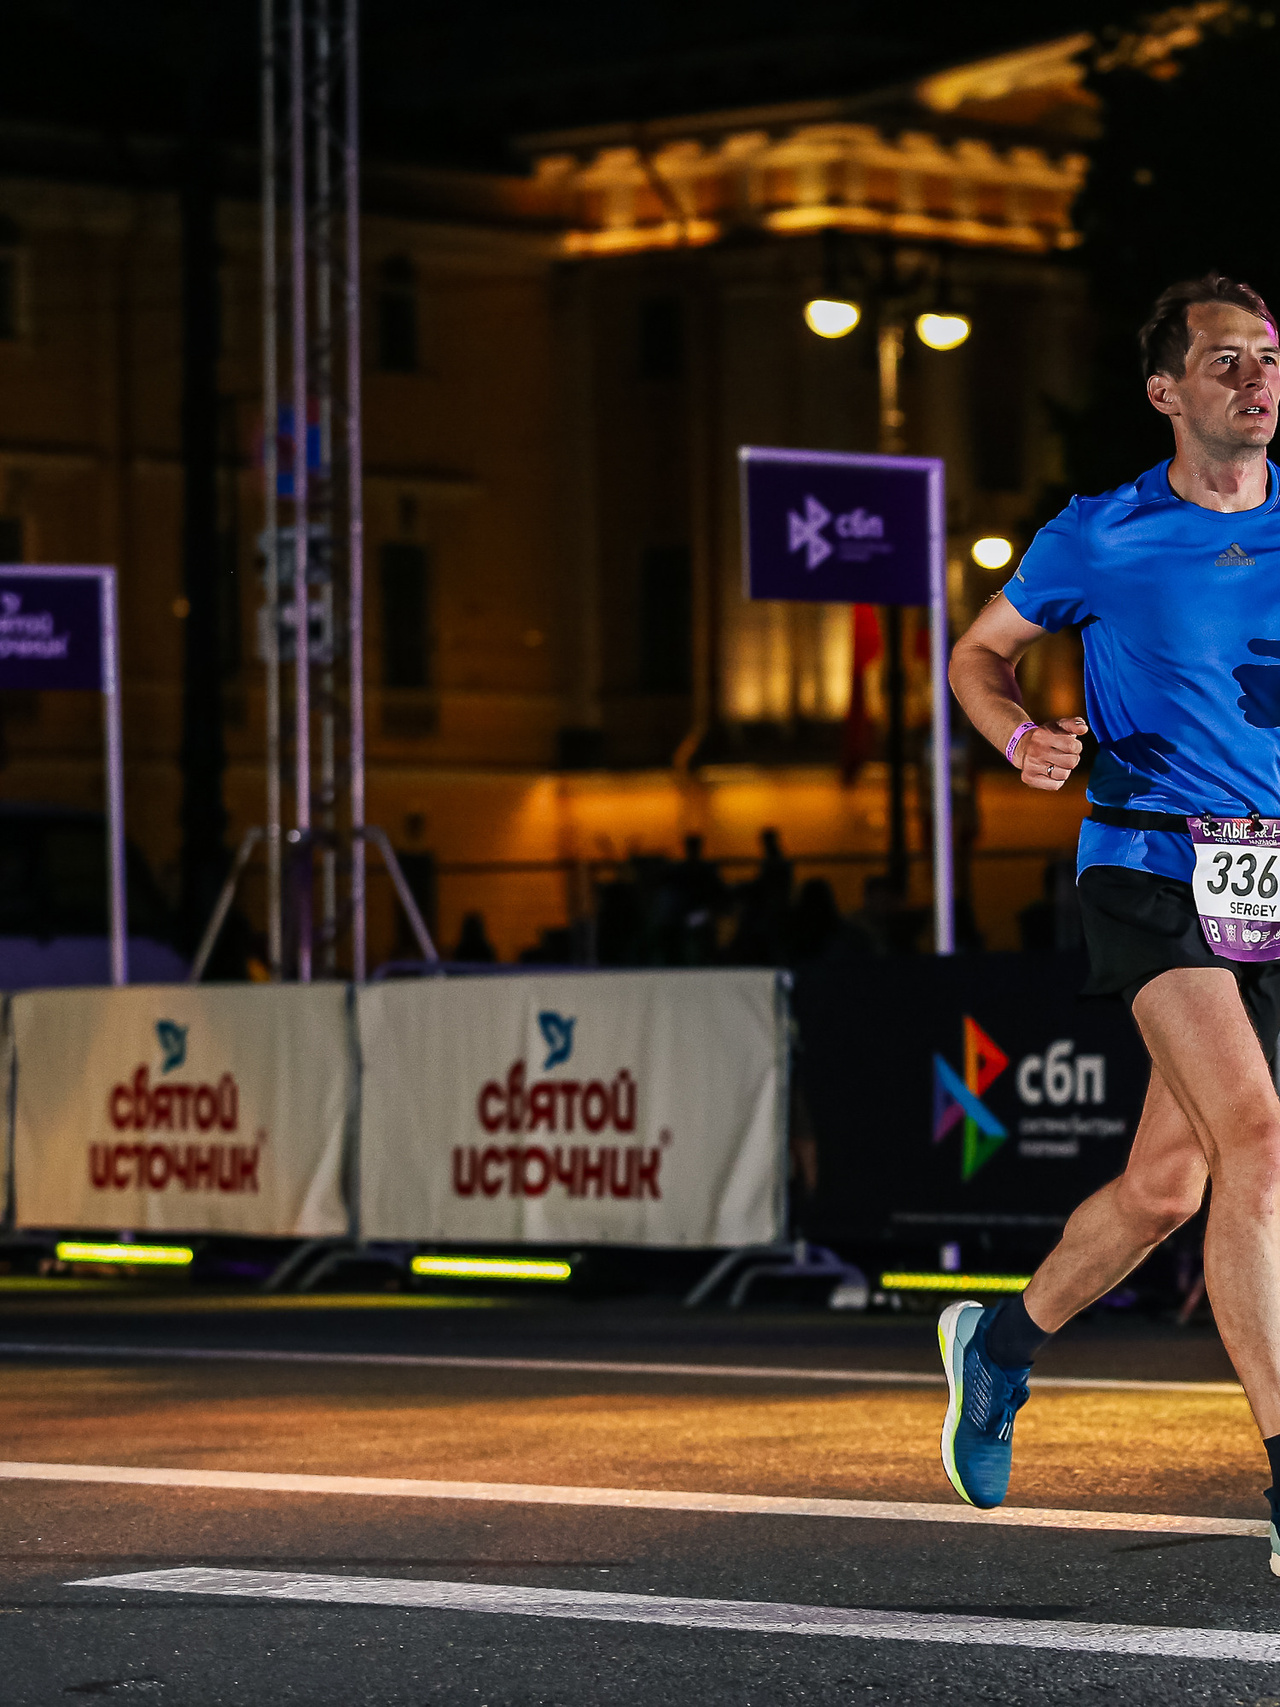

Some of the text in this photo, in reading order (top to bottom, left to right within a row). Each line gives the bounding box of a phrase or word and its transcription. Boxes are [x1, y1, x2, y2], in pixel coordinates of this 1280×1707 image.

[1214, 557, 1256, 567] adidas
[1229, 901, 1278, 918] SERGEY
[1017, 1040, 1106, 1105] сбп
